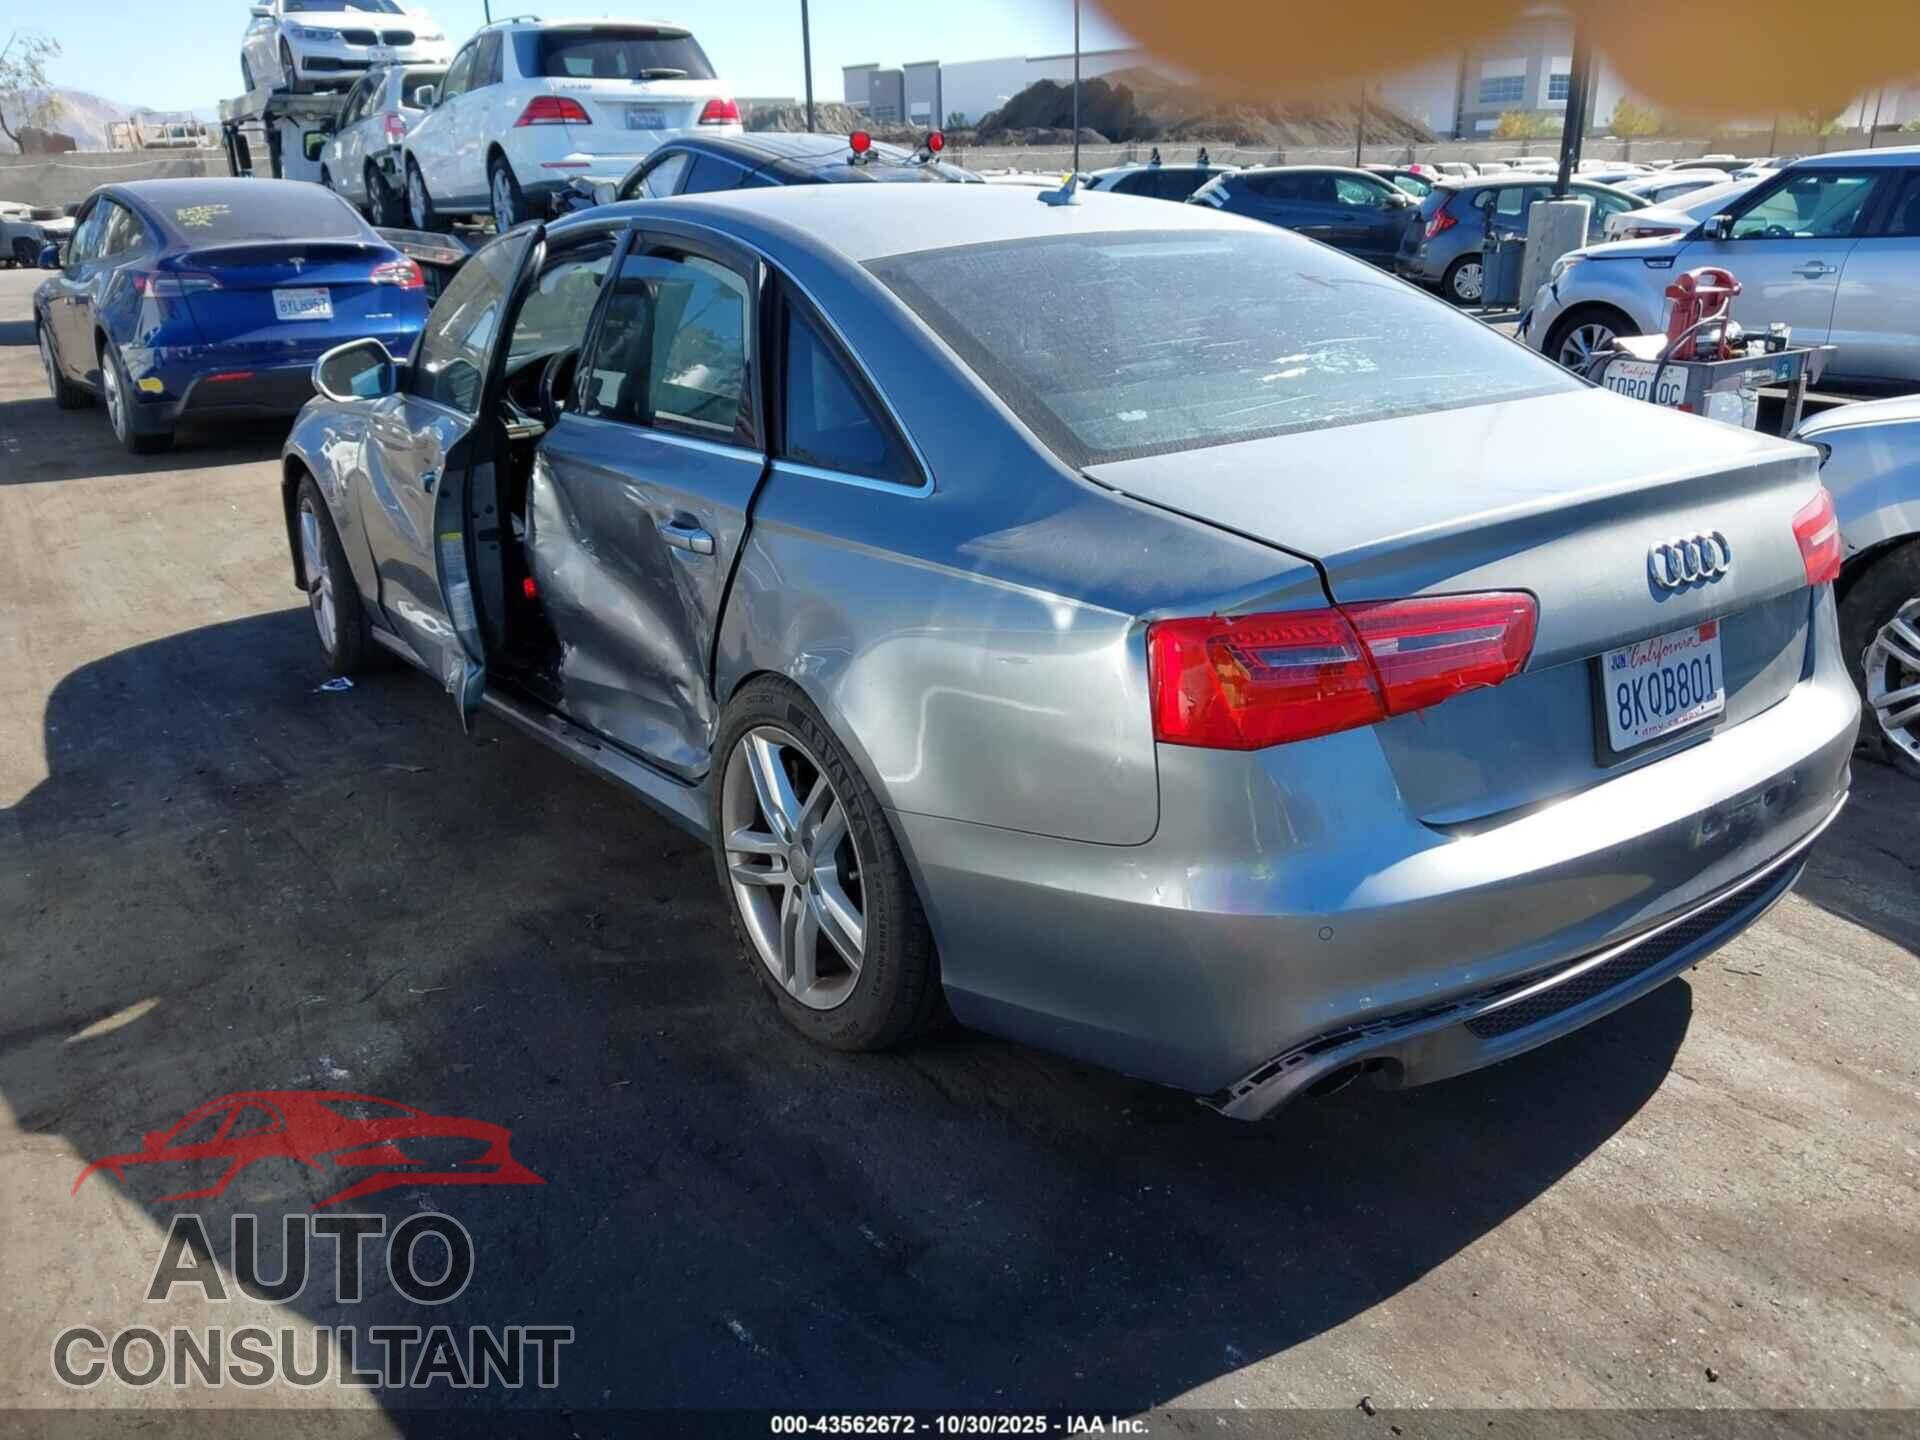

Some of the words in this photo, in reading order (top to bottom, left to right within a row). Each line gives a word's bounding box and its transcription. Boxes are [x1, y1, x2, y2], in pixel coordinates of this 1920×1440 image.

[1607, 376, 1681, 405] TOROOC
[1630, 637, 1700, 668] California
[1616, 652, 1716, 731] 8KQB801
